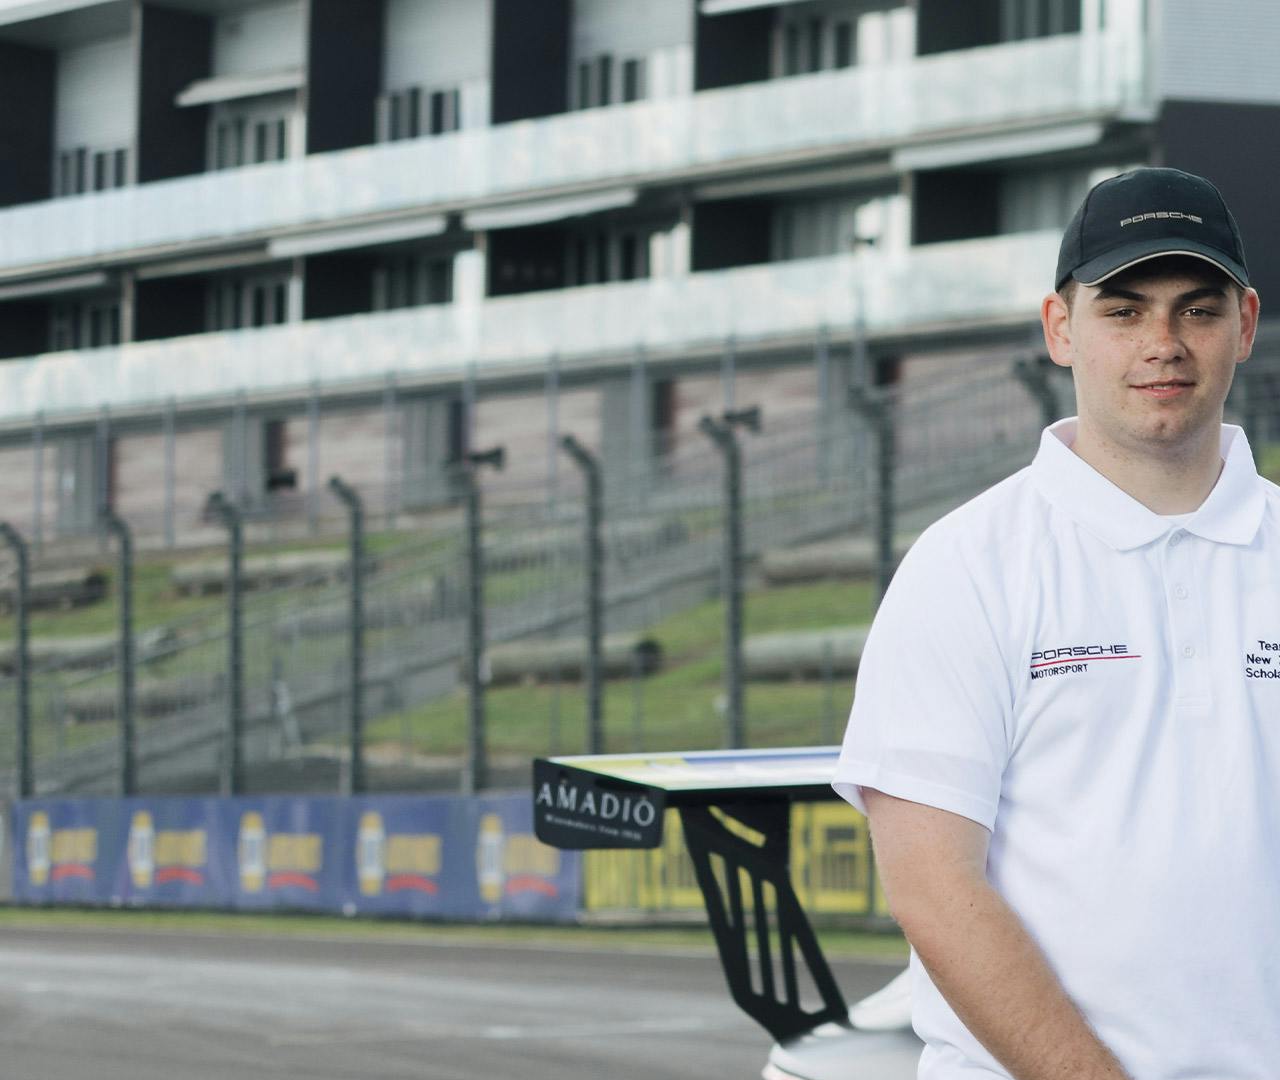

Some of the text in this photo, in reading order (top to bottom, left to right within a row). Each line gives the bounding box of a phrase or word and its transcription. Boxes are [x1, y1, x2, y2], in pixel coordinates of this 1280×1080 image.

[1119, 211, 1203, 227] PORSCHE
[1031, 644, 1128, 660] PORSCHE
[1246, 653, 1271, 665] New
[1030, 663, 1089, 680] MOTORSPORT
[536, 782, 656, 827] AMADIO
